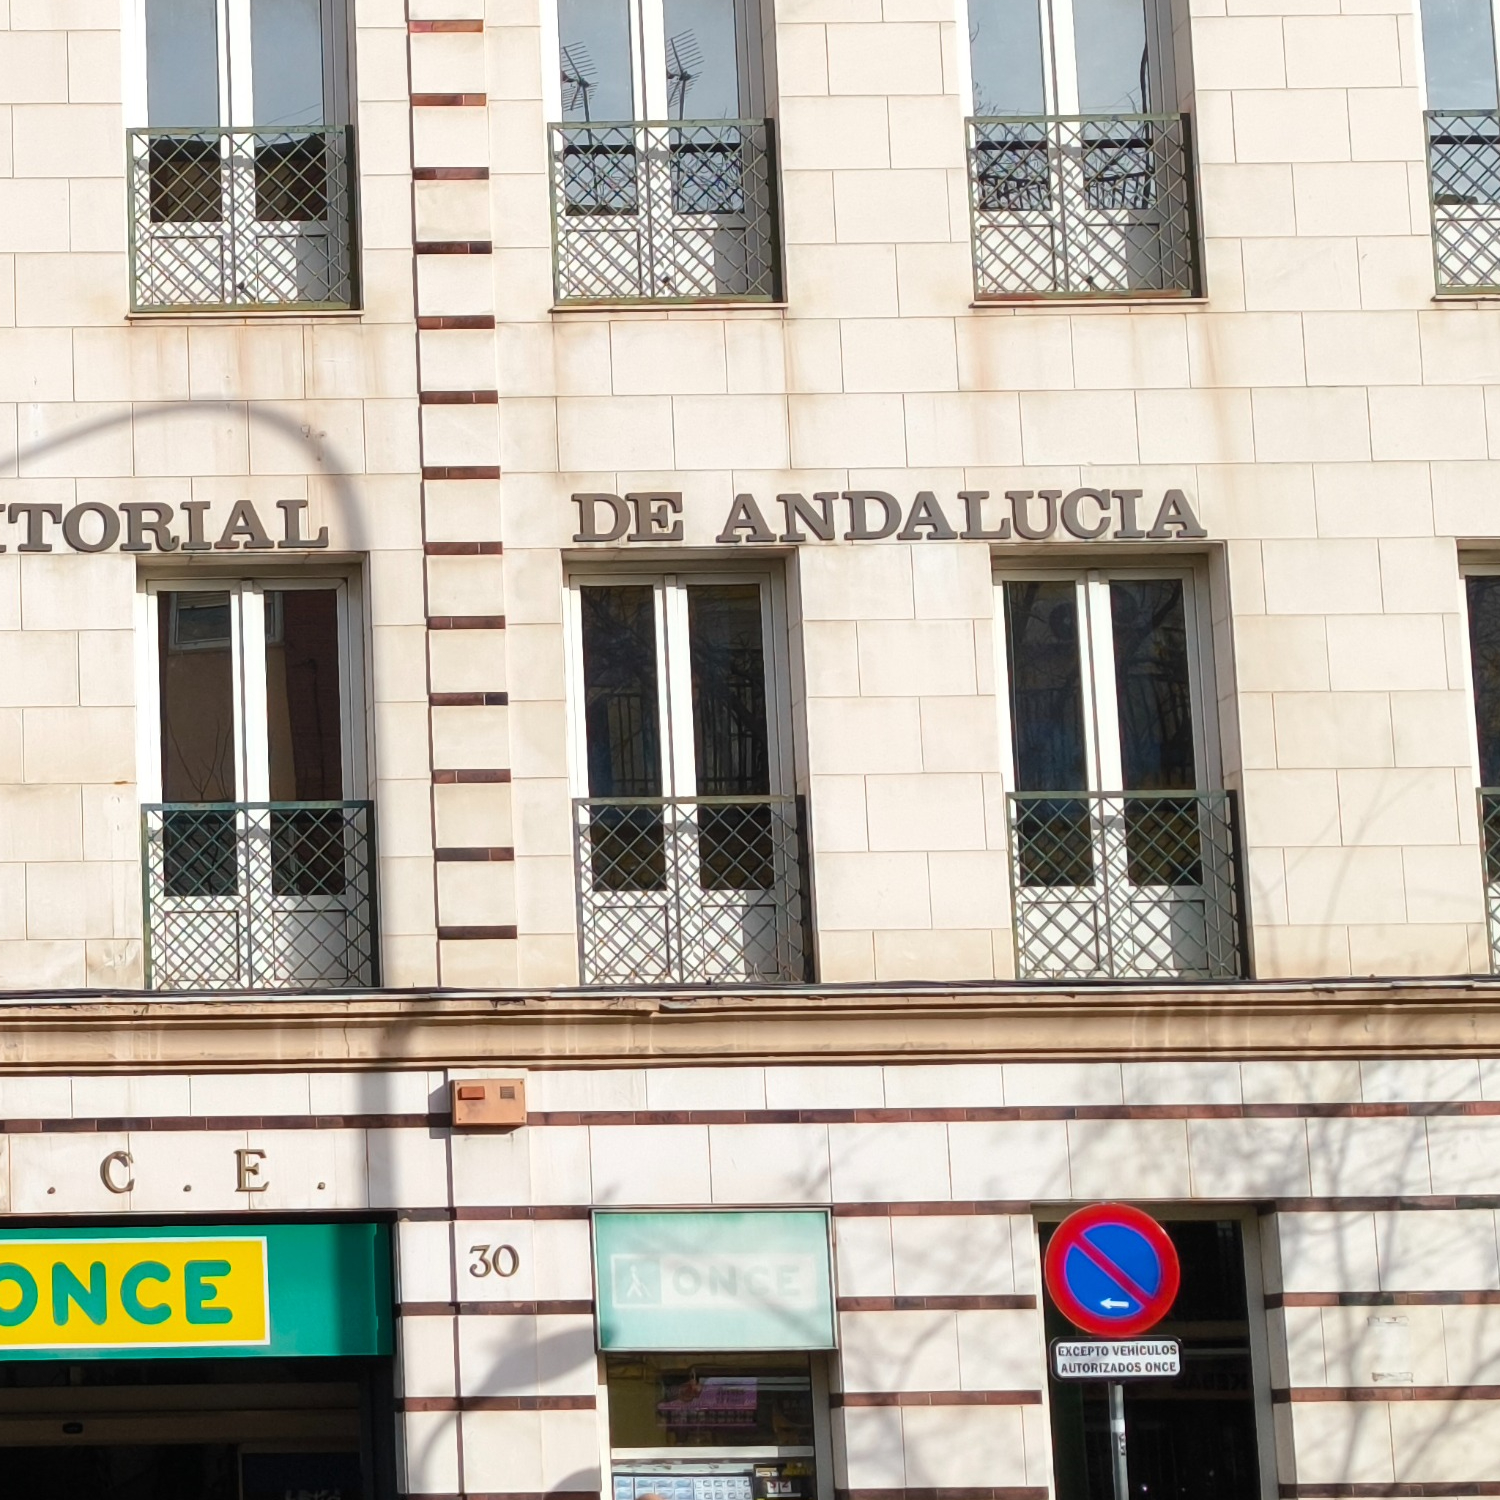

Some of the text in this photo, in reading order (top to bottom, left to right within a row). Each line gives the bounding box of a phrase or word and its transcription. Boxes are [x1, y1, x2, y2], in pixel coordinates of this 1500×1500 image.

[572, 491, 683, 542] DE
[716, 488, 1207, 542] ANDALUCIA
[469, 1244, 519, 1278] 30
[672, 1265, 802, 1298] ONCE
[1058, 1343, 1177, 1357] EXCEPTO VEHÍCULOS
[1061, 1361, 1177, 1373] AUTORIZADOS ONCE
